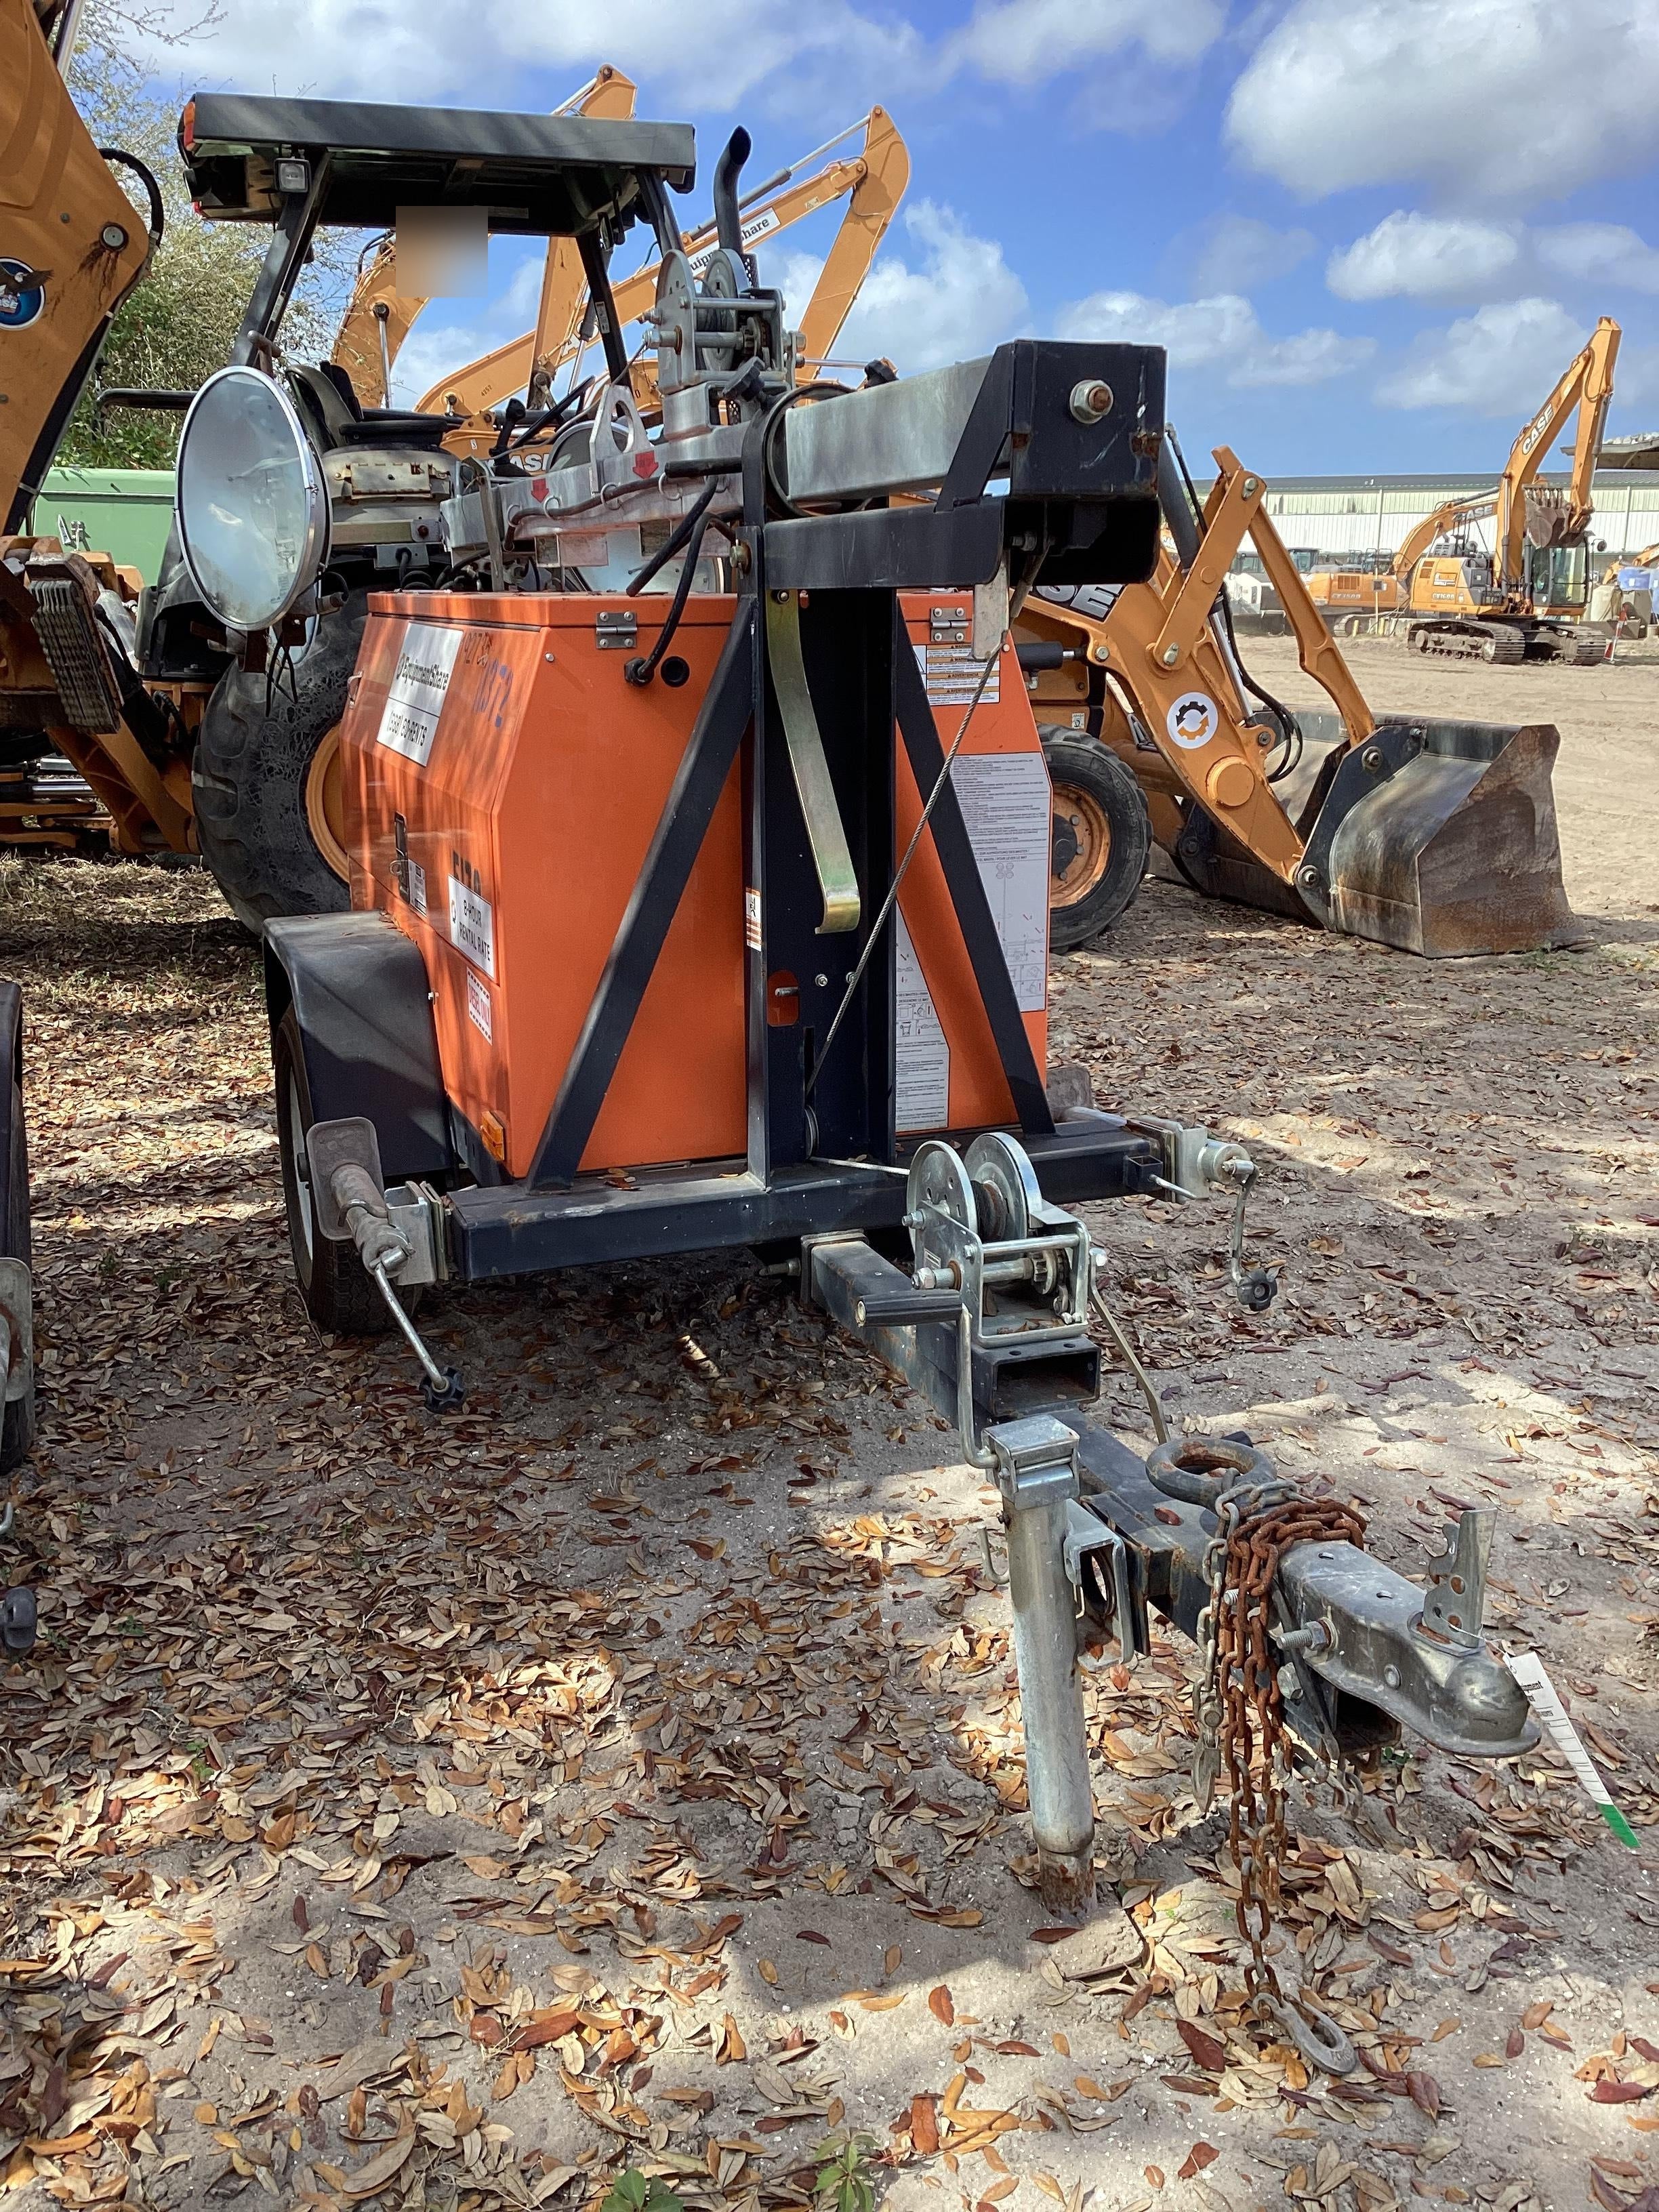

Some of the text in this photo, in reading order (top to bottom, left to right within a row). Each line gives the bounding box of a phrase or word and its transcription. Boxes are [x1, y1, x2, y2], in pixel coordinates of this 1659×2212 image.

[1522, 403, 1554, 455] CASE
[510, 453, 549, 472] AS
[464, 899, 482, 928] 8-HOUR
[459, 921, 490, 961] RENTAL RATE
